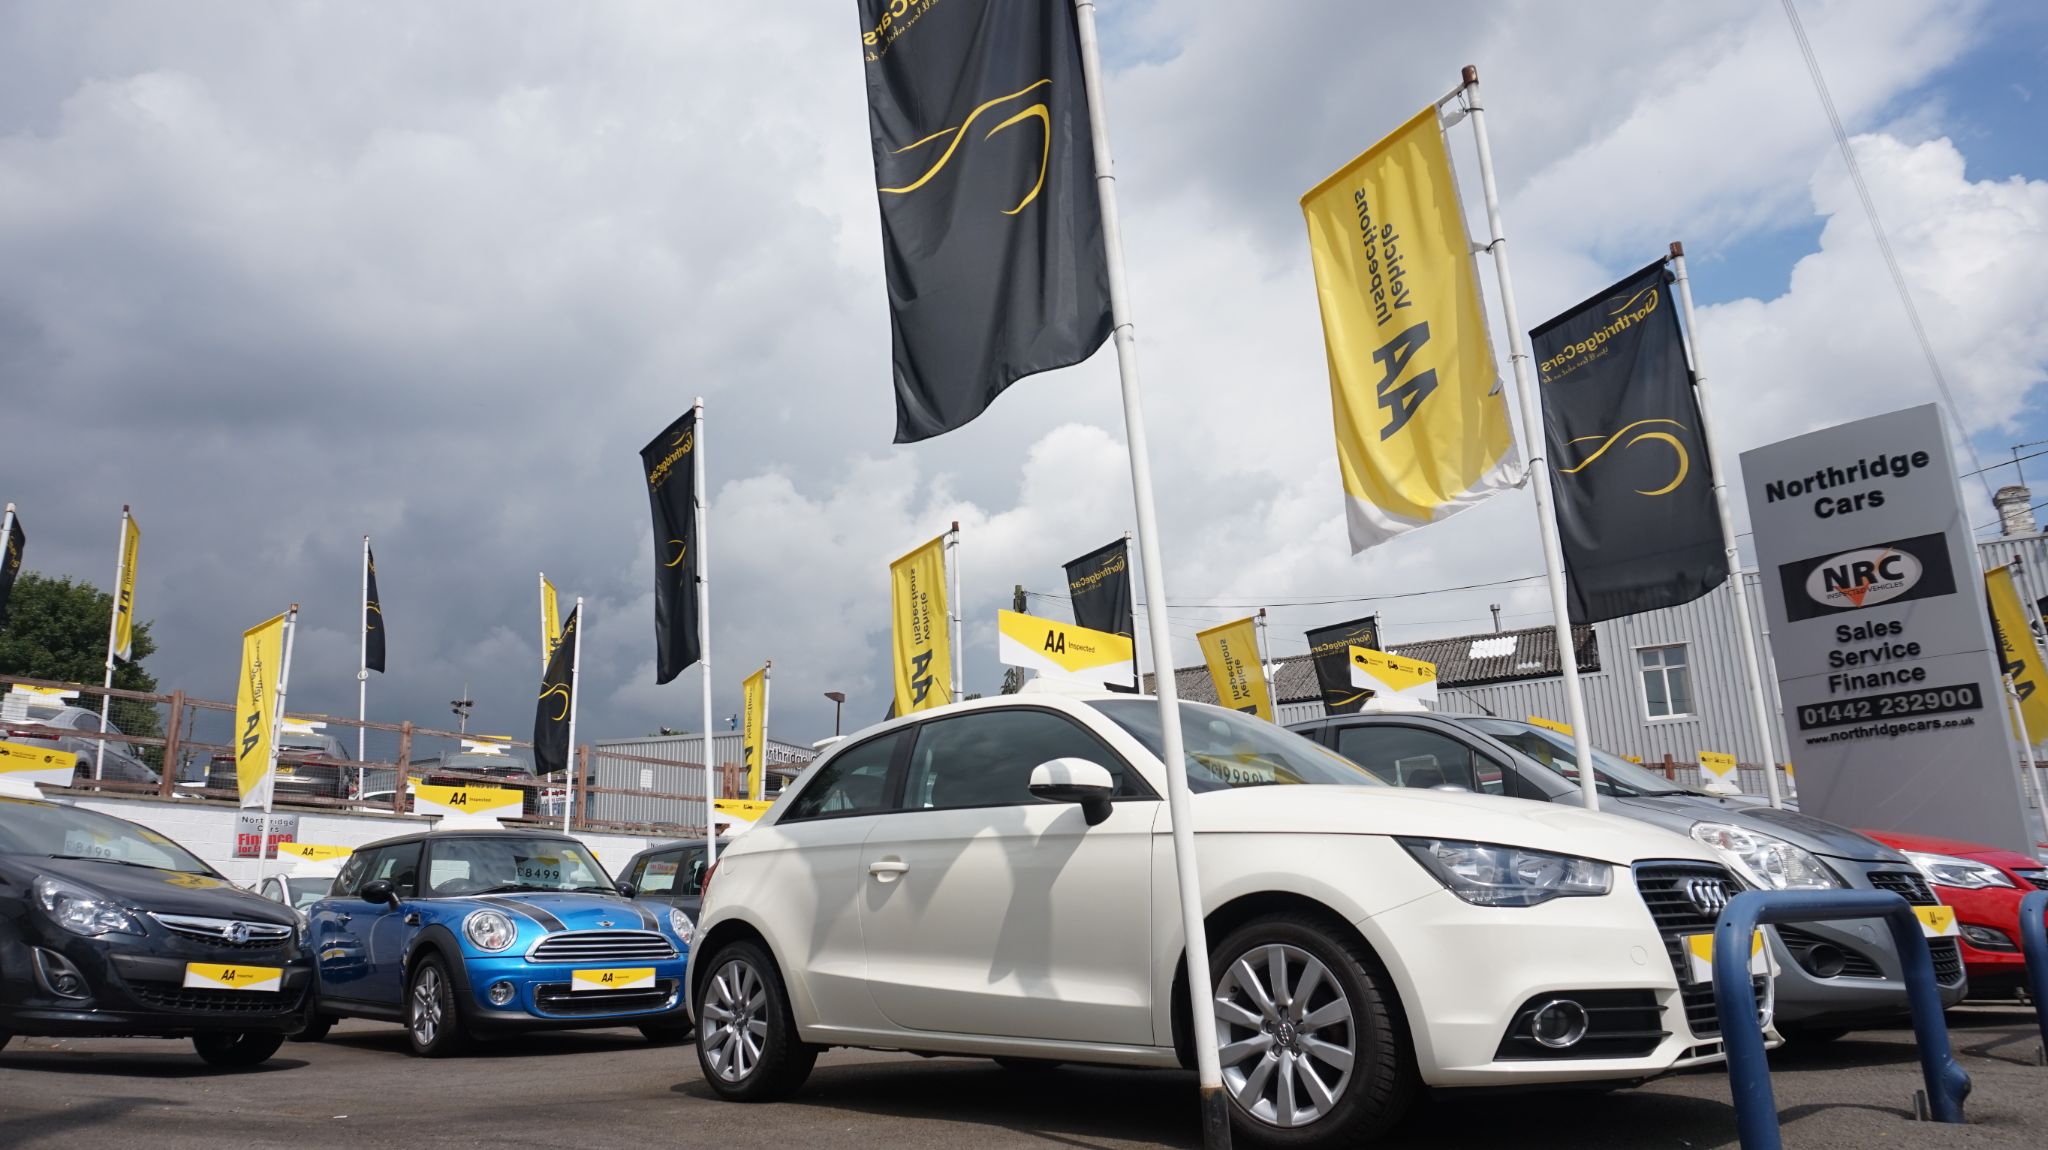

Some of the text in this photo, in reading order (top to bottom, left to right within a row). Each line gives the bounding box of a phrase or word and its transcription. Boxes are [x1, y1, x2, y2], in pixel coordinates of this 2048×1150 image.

[1765, 450, 1930, 503] Northridge
[1814, 490, 1886, 519] Cars
[1822, 555, 1905, 592] NRC
[1868, 580, 1904, 593] VEHICLES
[1836, 620, 1903, 643] Sales
[1044, 630, 1096, 655] AA Inspected
[1829, 642, 1921, 668] Service
[1829, 667, 1926, 694] Finance
[1804, 688, 1974, 726] 01442 232900
[1806, 717, 1975, 745] www.northridgecars.co.uk
[449, 792, 468, 806] AA
[242, 816, 295, 826] Nortridge
[257, 825, 279, 833] Crs
[238, 833, 293, 845] Finnce
[301, 847, 314, 856] AA
[517, 866, 560, 882] £8499
[221, 969, 236, 981] AA
[601, 972, 614, 983] AA
